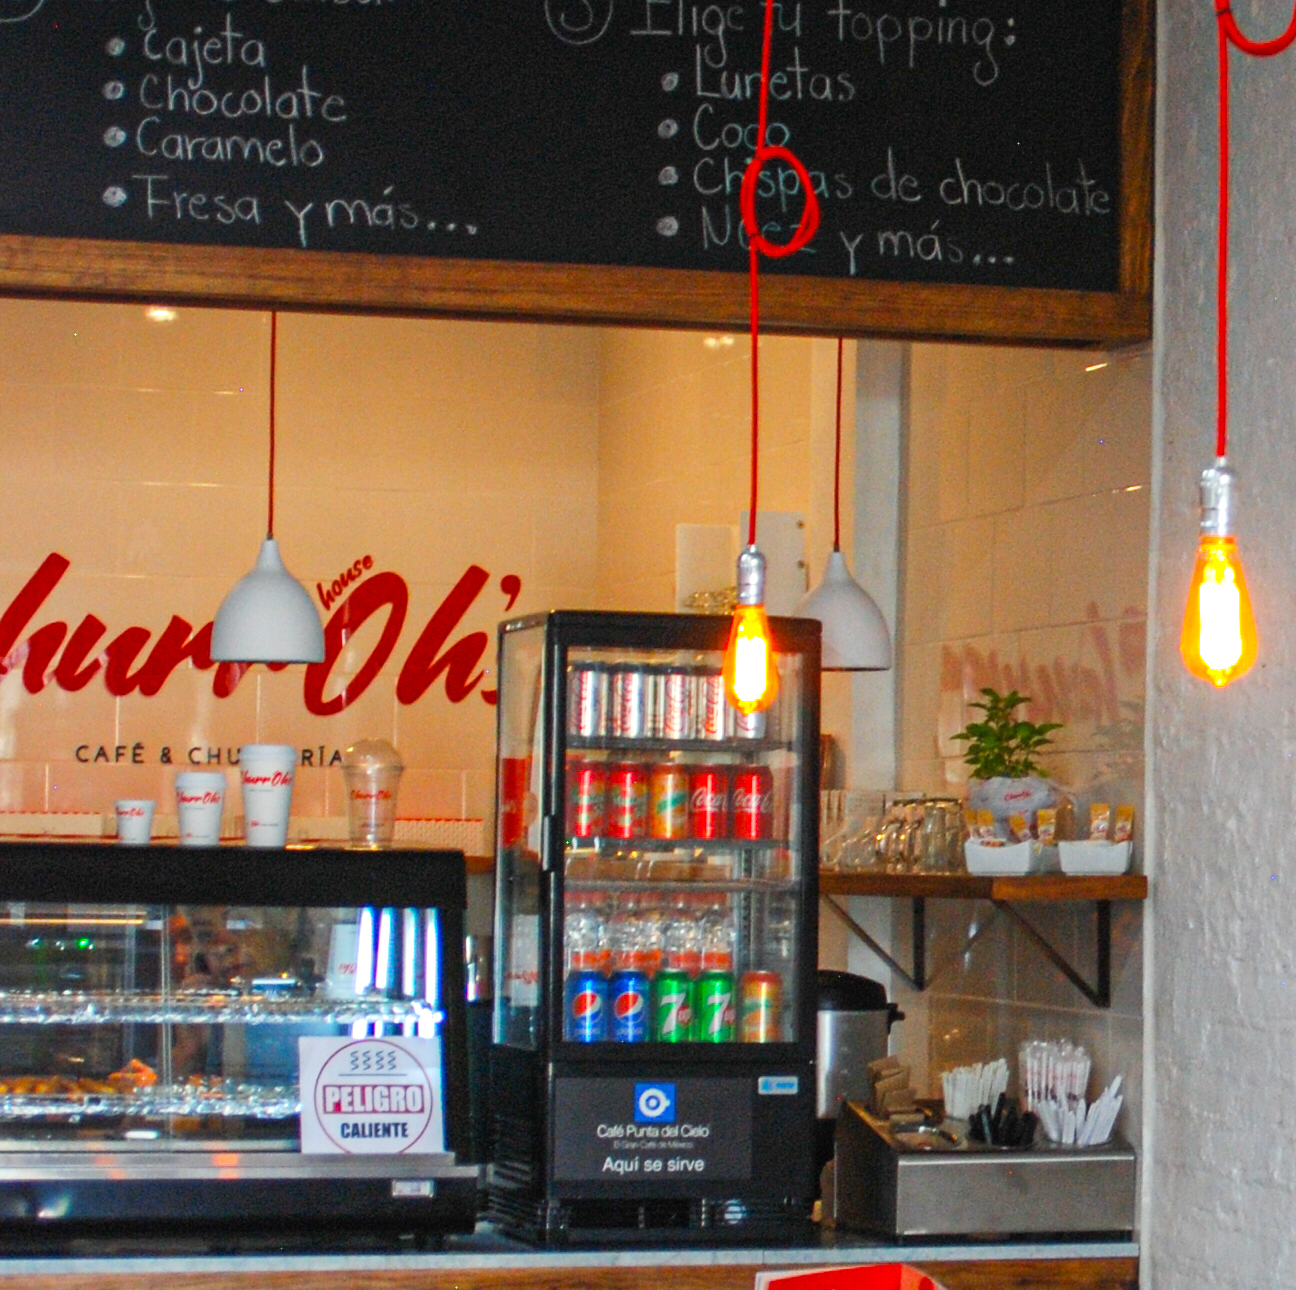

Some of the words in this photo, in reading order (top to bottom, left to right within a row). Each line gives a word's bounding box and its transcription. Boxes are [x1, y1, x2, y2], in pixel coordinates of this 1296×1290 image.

[143, 12, 266, 91] Cajeta
[139, 64, 348, 122] Chocolate
[136, 117, 325, 167] Caramelo
[132, 175, 261, 226] Fresa
[693, 156, 853, 213] Chspas
[871, 145, 922, 203] de
[940, 157, 1111, 216] chocolate
[316, 554, 375, 612] house
[75, 741, 145, 765] CAFÉ
[160, 746, 173, 764] &
[187, 744, 343, 767] CHURÍA
[325, 1084, 423, 1113] PELIGRO
[340, 1122, 409, 1139] CALIENTE
[597, 1123, 624, 1139] Café
[626, 1123, 659, 1139] Punta
[661, 1124, 679, 1138] del
[680, 1124, 710, 1139] Cielo
[602, 1156, 639, 1176] Aquí
[643, 1159, 663, 1172] se
